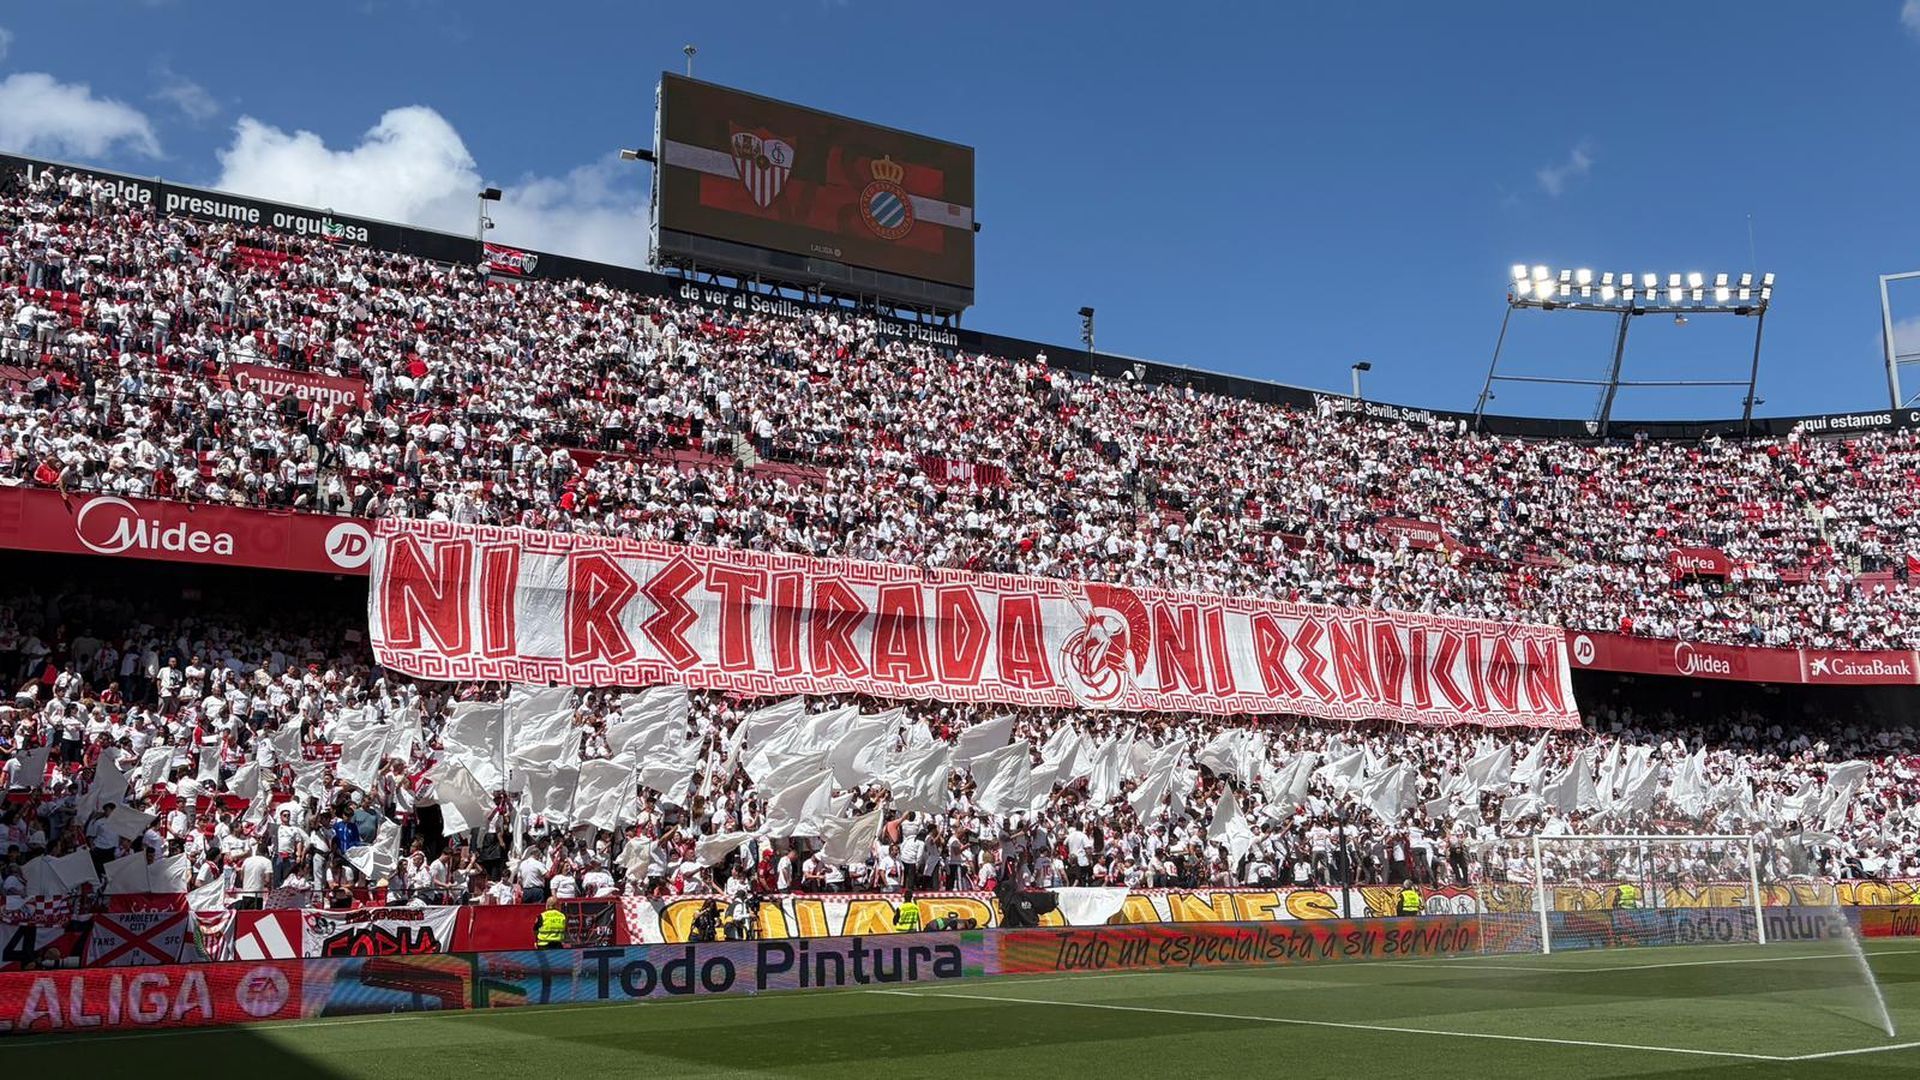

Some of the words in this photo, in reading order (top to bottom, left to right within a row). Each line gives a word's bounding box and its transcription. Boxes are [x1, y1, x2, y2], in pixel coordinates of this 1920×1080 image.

[166, 191, 260, 224] presume
[680, 283, 700, 301] de
[704, 289, 729, 306] ver
[733, 293, 747, 309] al
[751, 295, 801, 318] Sevilla
[1831, 412, 1892, 428] estamos
[100, 516, 234, 556] Midea
[331, 533, 367, 556] JD
[379, 532, 520, 660] NI
[564, 549, 1056, 690] RETIRADA
[1155, 600, 1237, 698] NI
[1250, 609, 1568, 717] RENDICIÓN
[1686, 652, 1730, 674] Midea
[1831, 658, 1911, 676] CaixaBank
[1056, 932, 1108, 970] Todo
[1117, 935, 1149, 965] un
[1158, 926, 1314, 968] especialista
[1321, 934, 1337, 957] a
[1343, 927, 1374, 955] su
[1382, 922, 1469, 954] servicio
[583, 945, 736, 999] Todo
[757, 937, 963, 990] Pintura
[0, 969, 213, 1032] ALIGA
